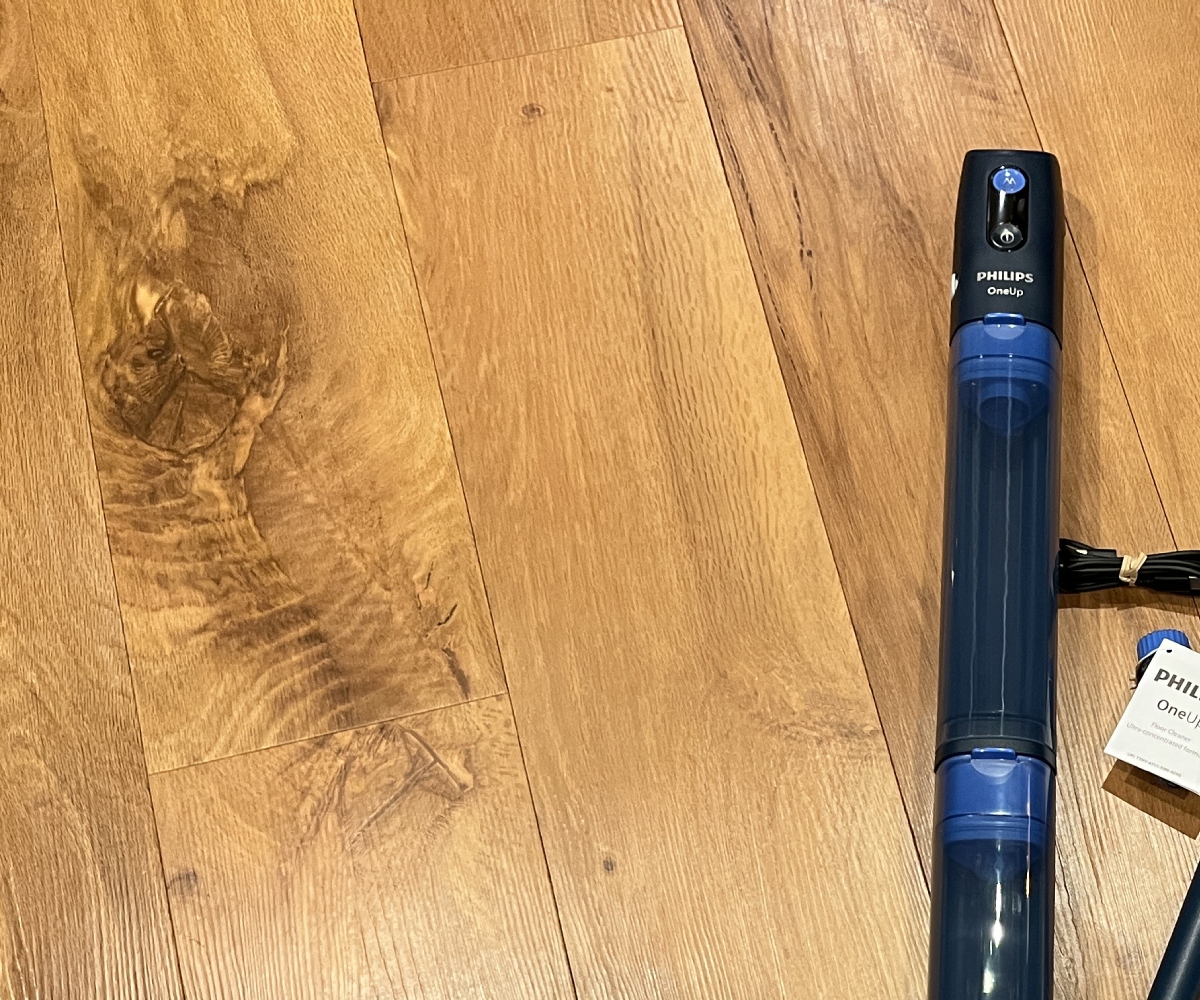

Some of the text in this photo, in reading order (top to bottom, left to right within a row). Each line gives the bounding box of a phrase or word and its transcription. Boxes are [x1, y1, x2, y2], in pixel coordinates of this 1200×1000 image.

[976, 271, 1034, 283] PHILIPS
[987, 286, 1024, 298] OneUp
[1167, 728, 1191, 743] Cleaner
